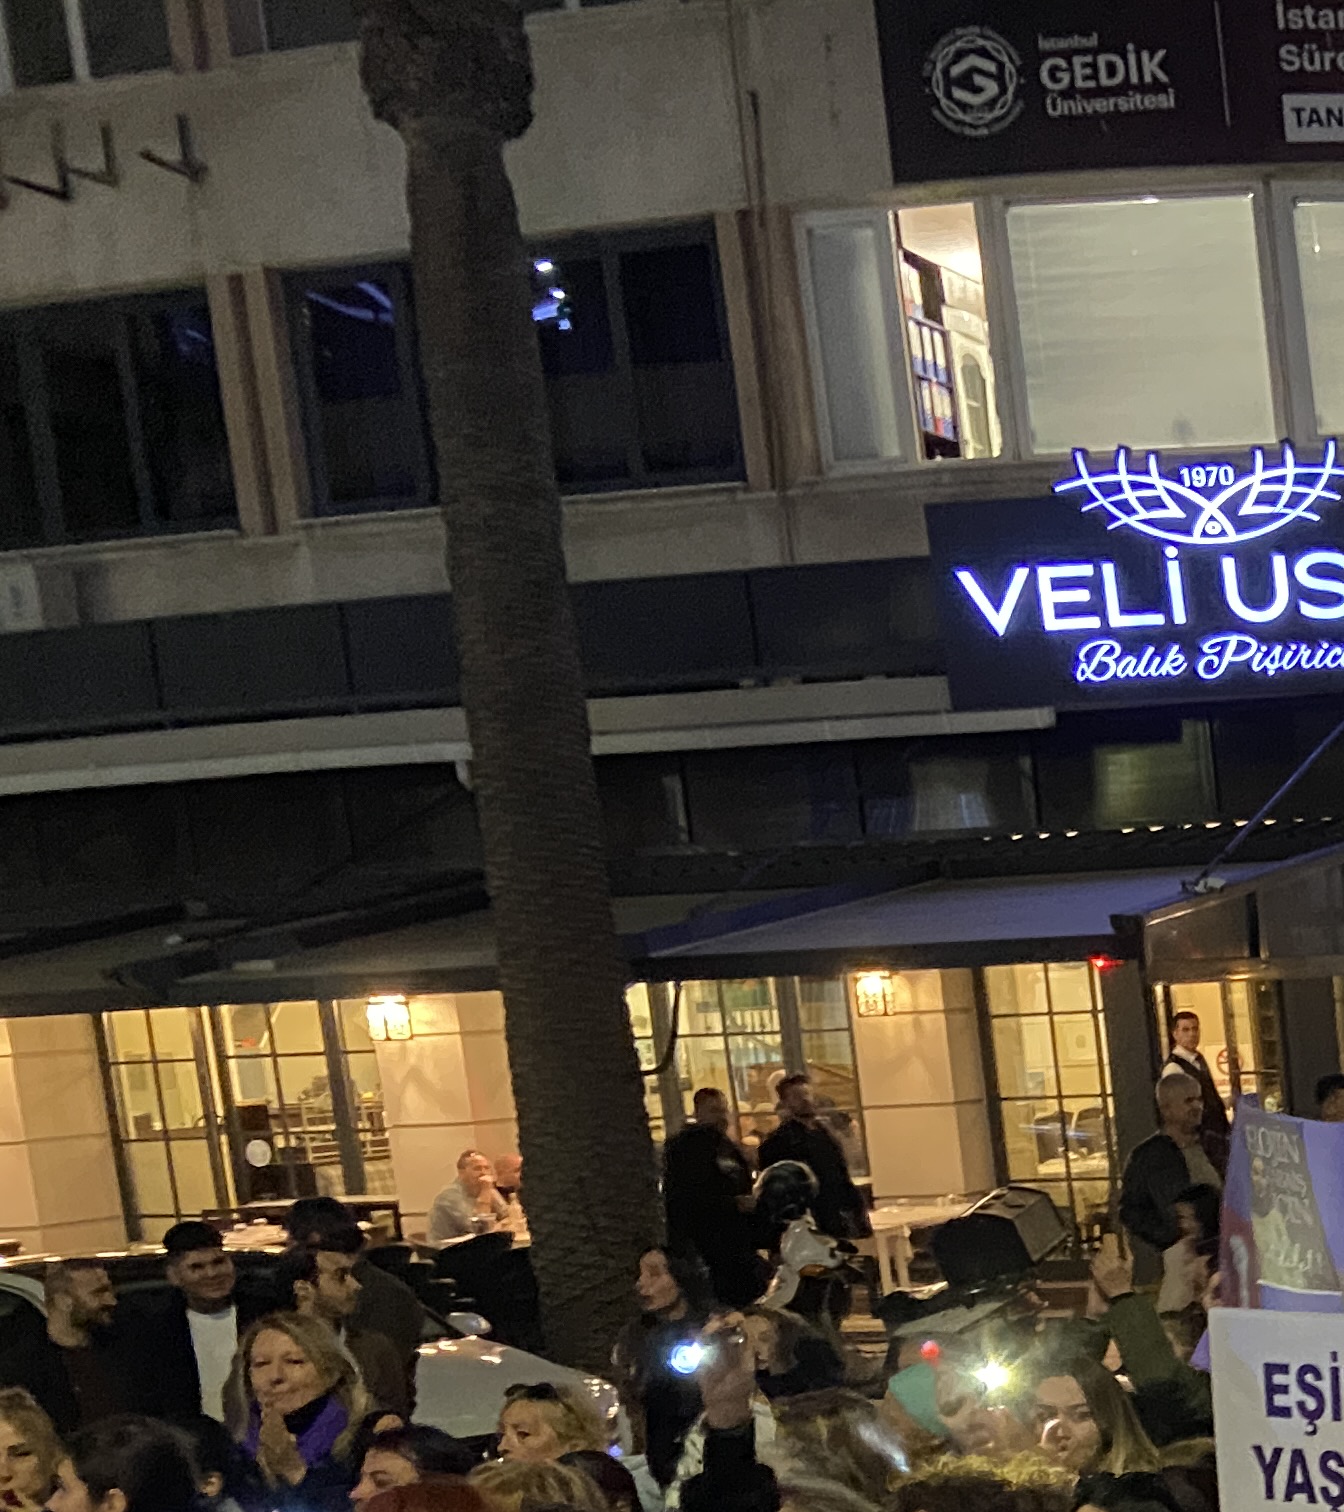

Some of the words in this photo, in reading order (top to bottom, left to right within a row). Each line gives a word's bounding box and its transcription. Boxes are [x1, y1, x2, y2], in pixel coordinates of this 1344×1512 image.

[1039, 43, 1169, 90] GEDİK
[1046, 88, 1175, 117] Üniversitesi
[1179, 465, 1235, 489] 1970
[954, 545, 1187, 638] VELİ
[1075, 638, 1188, 682] Balık
